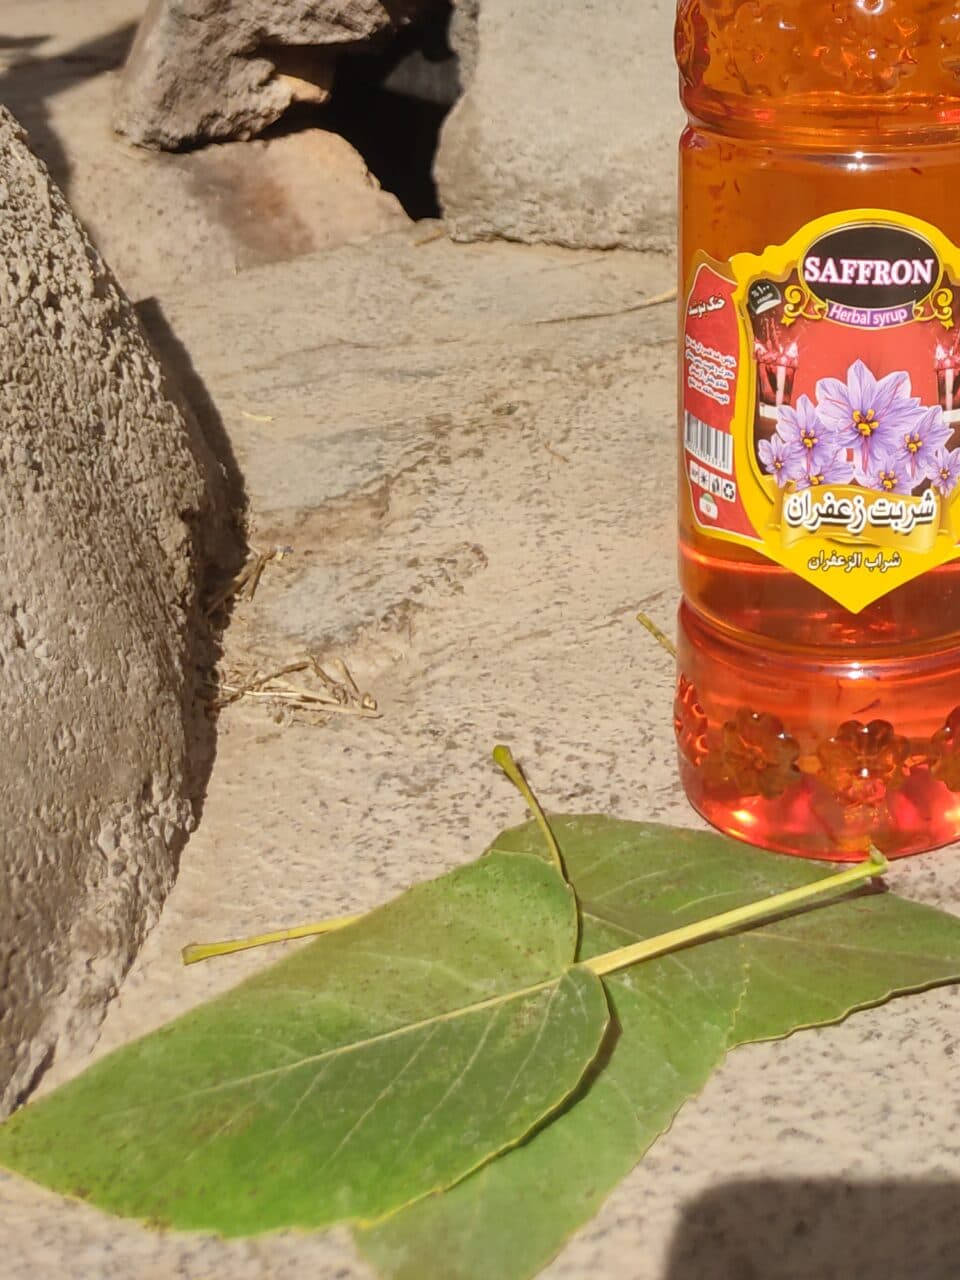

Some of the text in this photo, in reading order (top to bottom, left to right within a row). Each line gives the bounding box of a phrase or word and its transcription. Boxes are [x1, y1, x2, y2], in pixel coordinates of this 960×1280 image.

[804, 256, 935, 286] SAFFRON
[828, 303, 908, 328] Herbal syrup
[784, 489, 937, 535] شربت زعفران
[807, 550, 901, 573] شراب الزعفران
